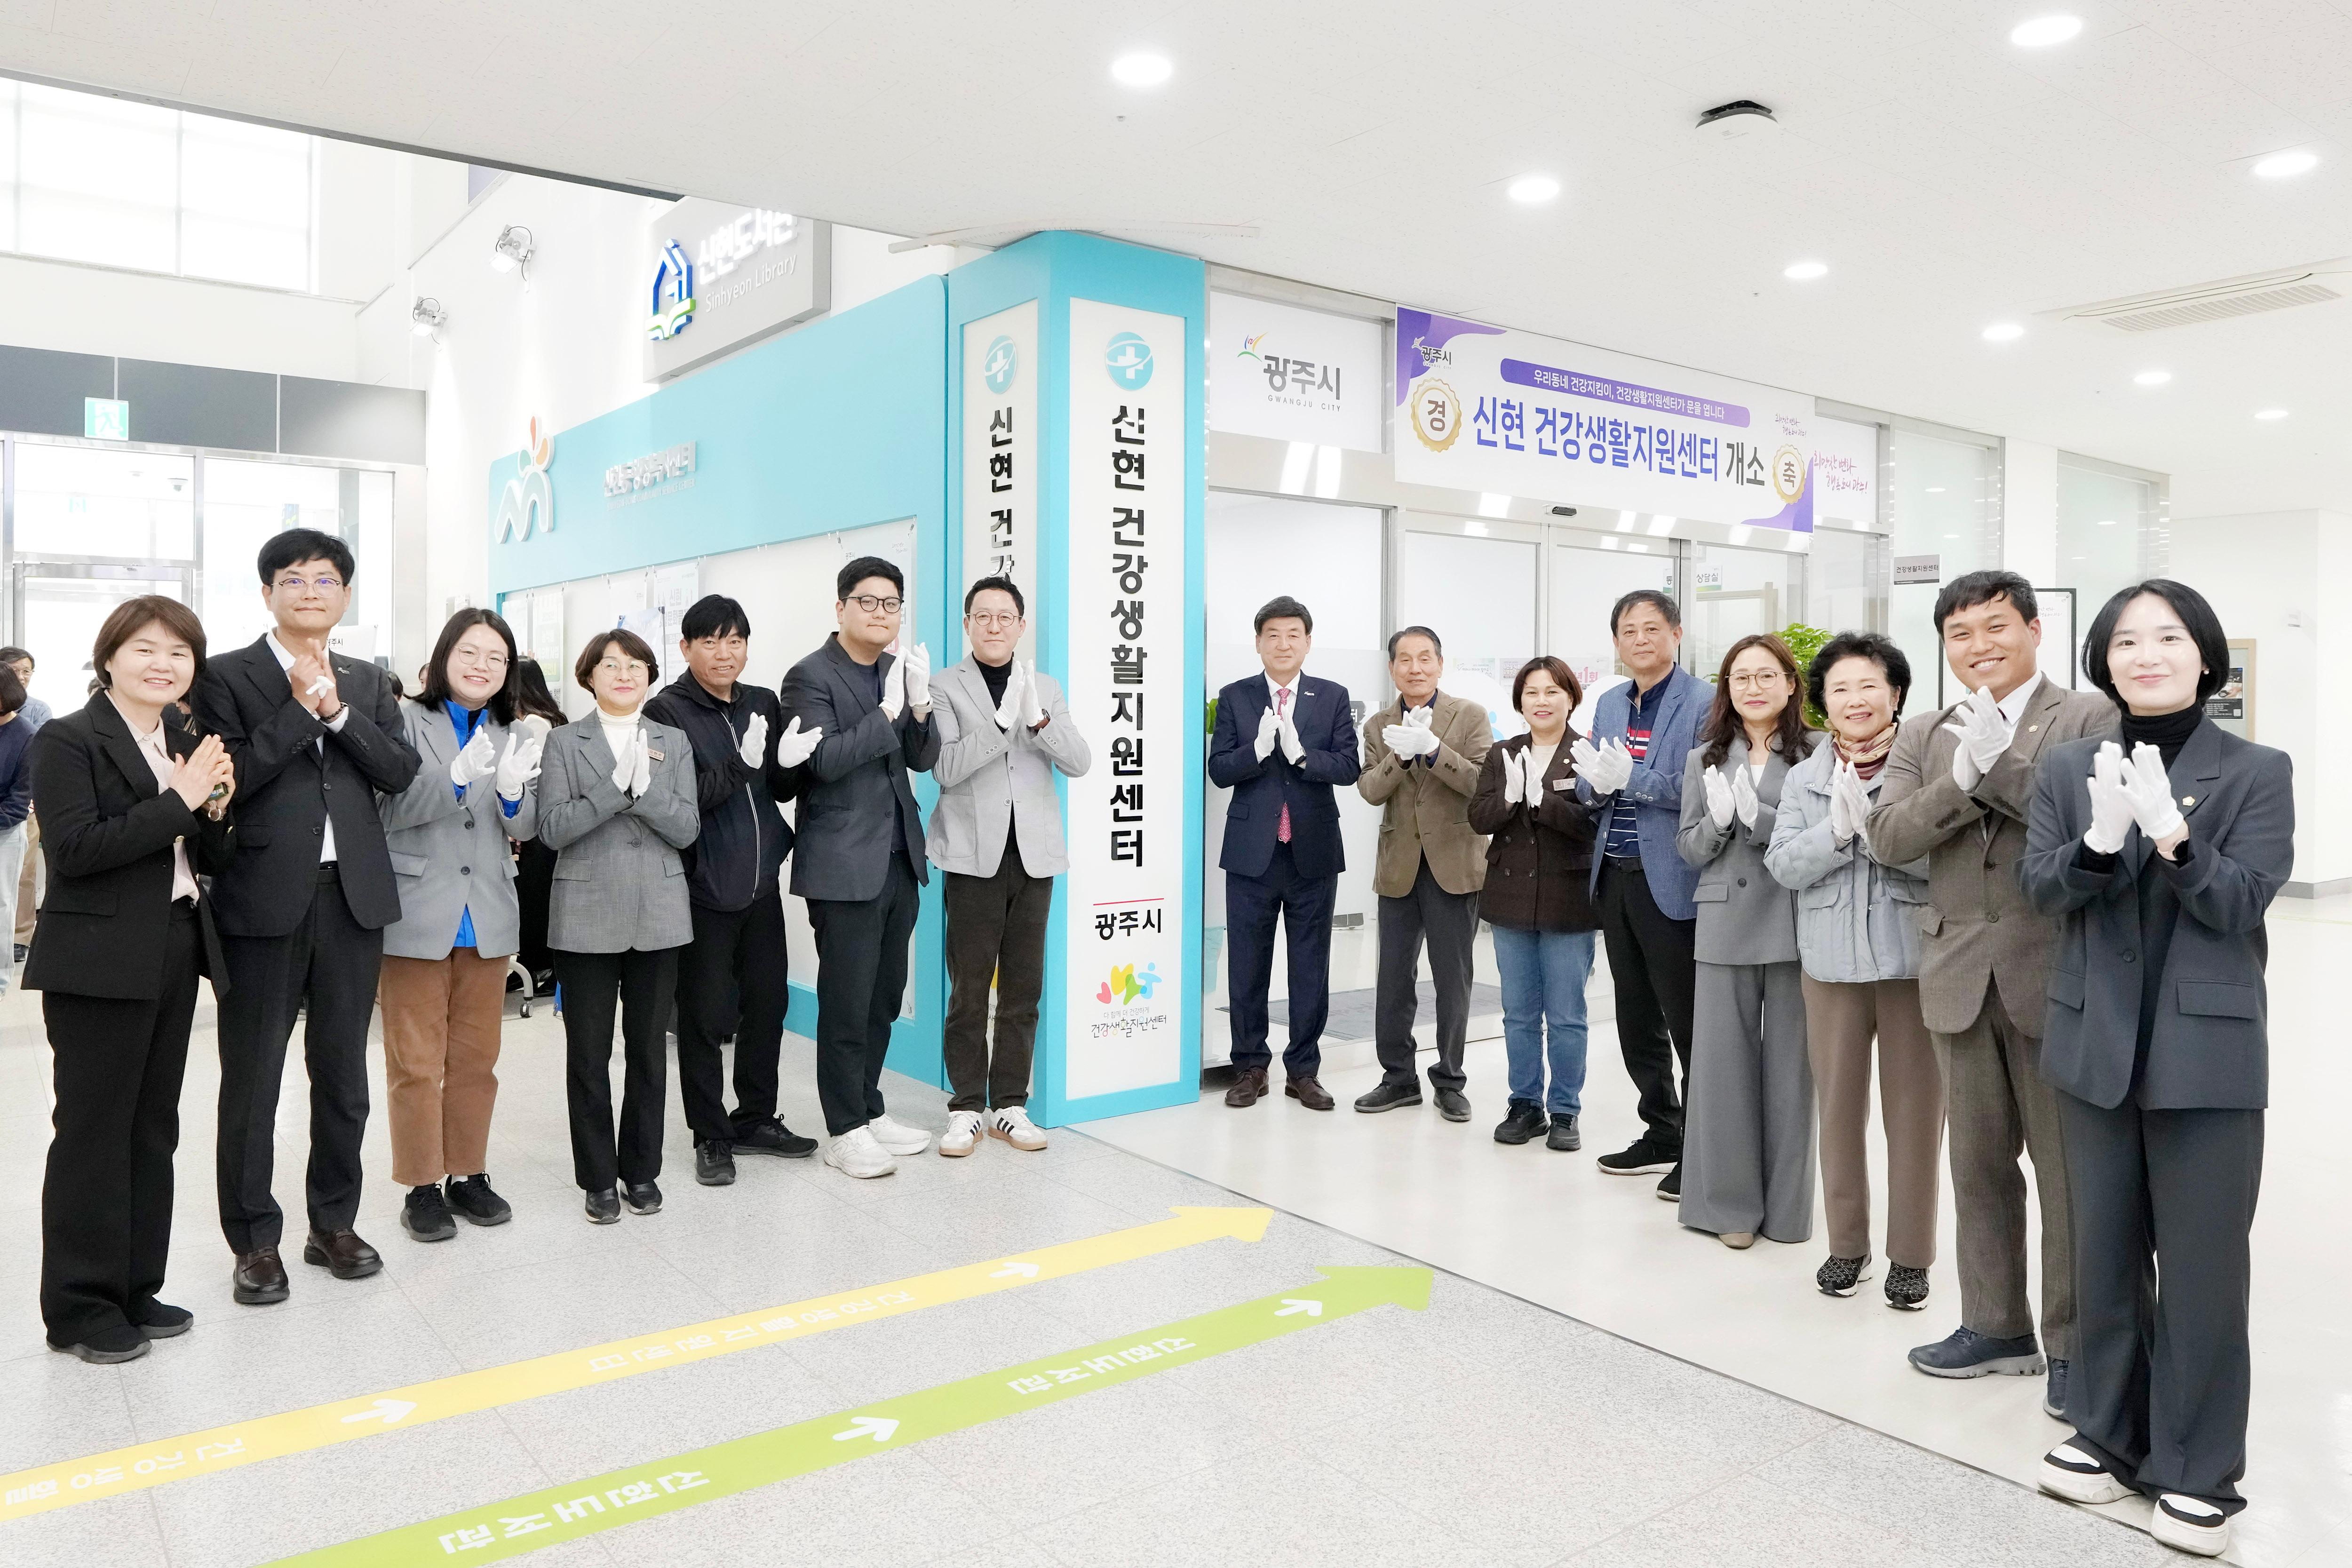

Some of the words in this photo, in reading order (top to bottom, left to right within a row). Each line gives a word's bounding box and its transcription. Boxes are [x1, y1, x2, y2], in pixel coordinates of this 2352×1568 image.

[706, 277, 752, 313] Sinhyeon
[755, 254, 797, 288] Library
[1422, 346, 1451, 365] 광주시
[1263, 355, 1340, 400] 광주시
[1534, 369, 1569, 390] 우리동네
[1571, 376, 1614, 400] 건강지킴이,
[1616, 386, 1685, 412] 건강생활지원센터가
[1686, 400, 1702, 415] 문을
[1703, 403, 1725, 420] 엽니다
[1268, 395, 1312, 408] GWANGJU
[1321, 403, 1341, 412] CITY
[1428, 399, 1446, 432] 경
[990, 406, 1012, 493] 신현
[1112, 405, 1145, 491] 신현
[1473, 396, 1525, 453] 신현
[1535, 407, 1718, 482] 건강생활지원센터
[1726, 442, 1765, 486] 개소
[1814, 450, 1837, 471] 희망찬
[1783, 461, 1796, 488] 축
[1852, 476, 1868, 494] 광주!
[1696, 573, 1718, 583] 상담실
[1896, 565, 1939, 573] 건강생활지원센터
[1110, 507, 1148, 868] 건강생활지원센터
[1094, 908, 1162, 940] 광주시
[1091, 1015, 1167, 1038] 건강생활지원센터
[1129, 1006, 1150, 1016] 건강하게
[588, 1290, 916, 1373] 건강생활지원센터
[1006, 1337, 1197, 1395] 신현도서관
[5, 1438, 247, 1505] 건강생활
[437, 1471, 711, 1555] 신현도서관
